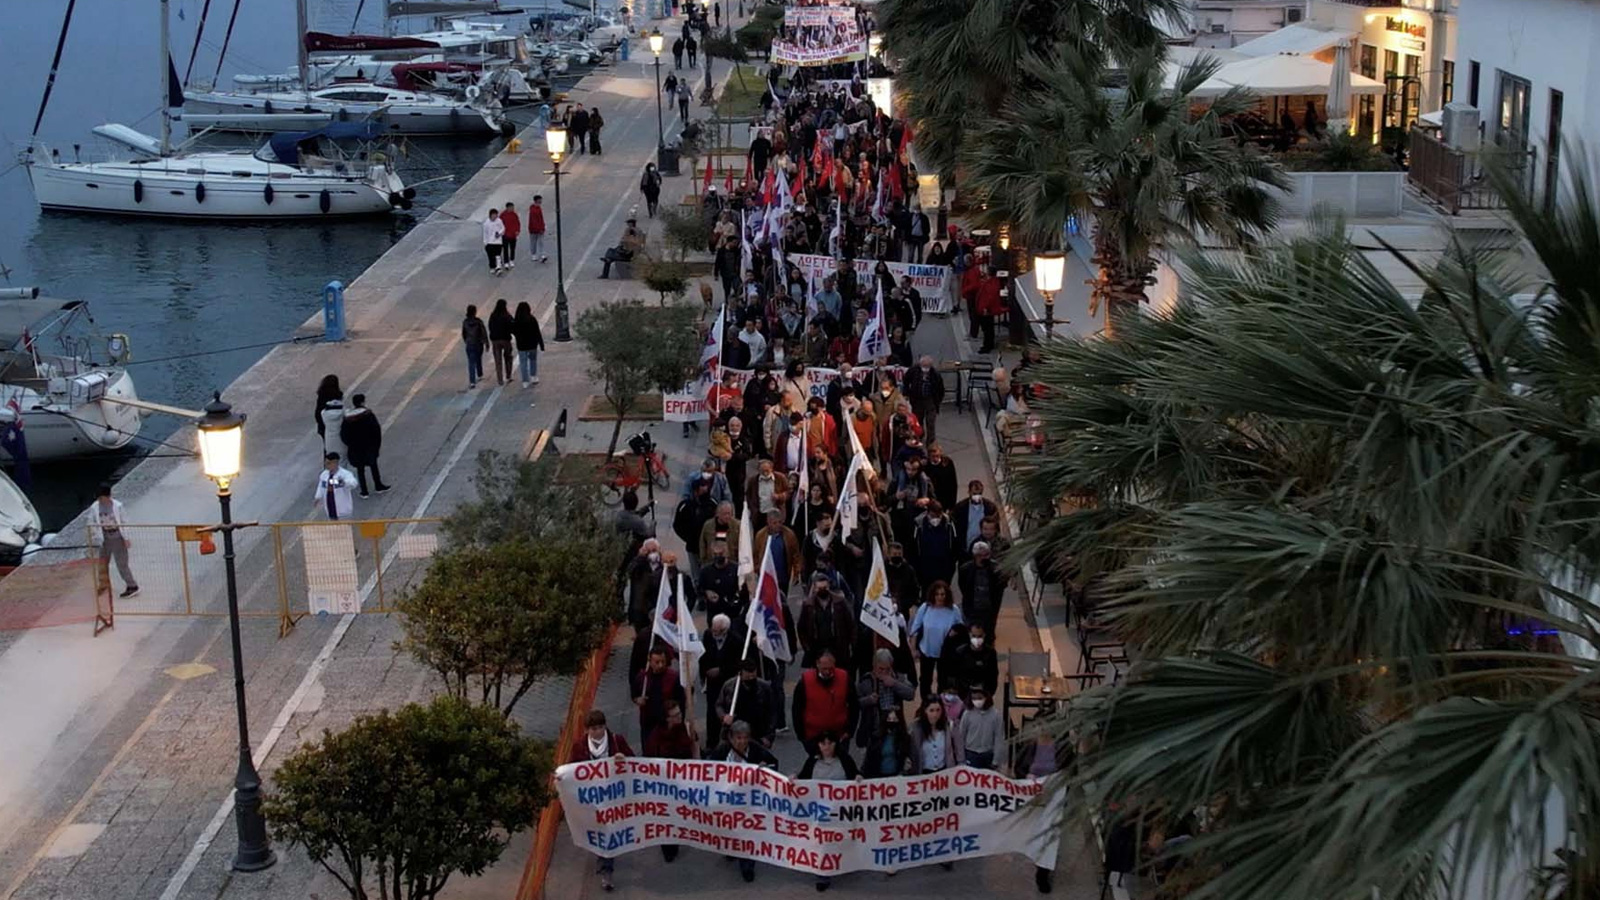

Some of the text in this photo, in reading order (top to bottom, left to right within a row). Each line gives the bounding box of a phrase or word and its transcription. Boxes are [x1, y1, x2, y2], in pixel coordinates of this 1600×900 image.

[665, 400, 707, 413] ΕΡΓΑΤΙΚ
[574, 761, 609, 780] ΟΧΙ
[614, 760, 660, 776] ΣΤΟΝ
[818, 782, 897, 801] ΠΟΛΕΜΟ
[906, 775, 949, 795] ΣΤΗΝ
[578, 780, 626, 804] ΚΑΜΙΑ
[715, 790, 747, 805] ΤΗΣ
[974, 792, 1026, 814] ΒΑΣΕ
[595, 801, 670, 825] ΚΑΝΕΝΑΣ
[675, 804, 767, 831] ΦΑΝΤΑΡΟΣ
[774, 815, 810, 840] ΕΞΩ
[848, 827, 866, 843] ΤΑ
[880, 813, 960, 843] ΣΥΝΟΡΑ
[871, 834, 981, 867] ΠΡΕΒΕΖΑΣ
